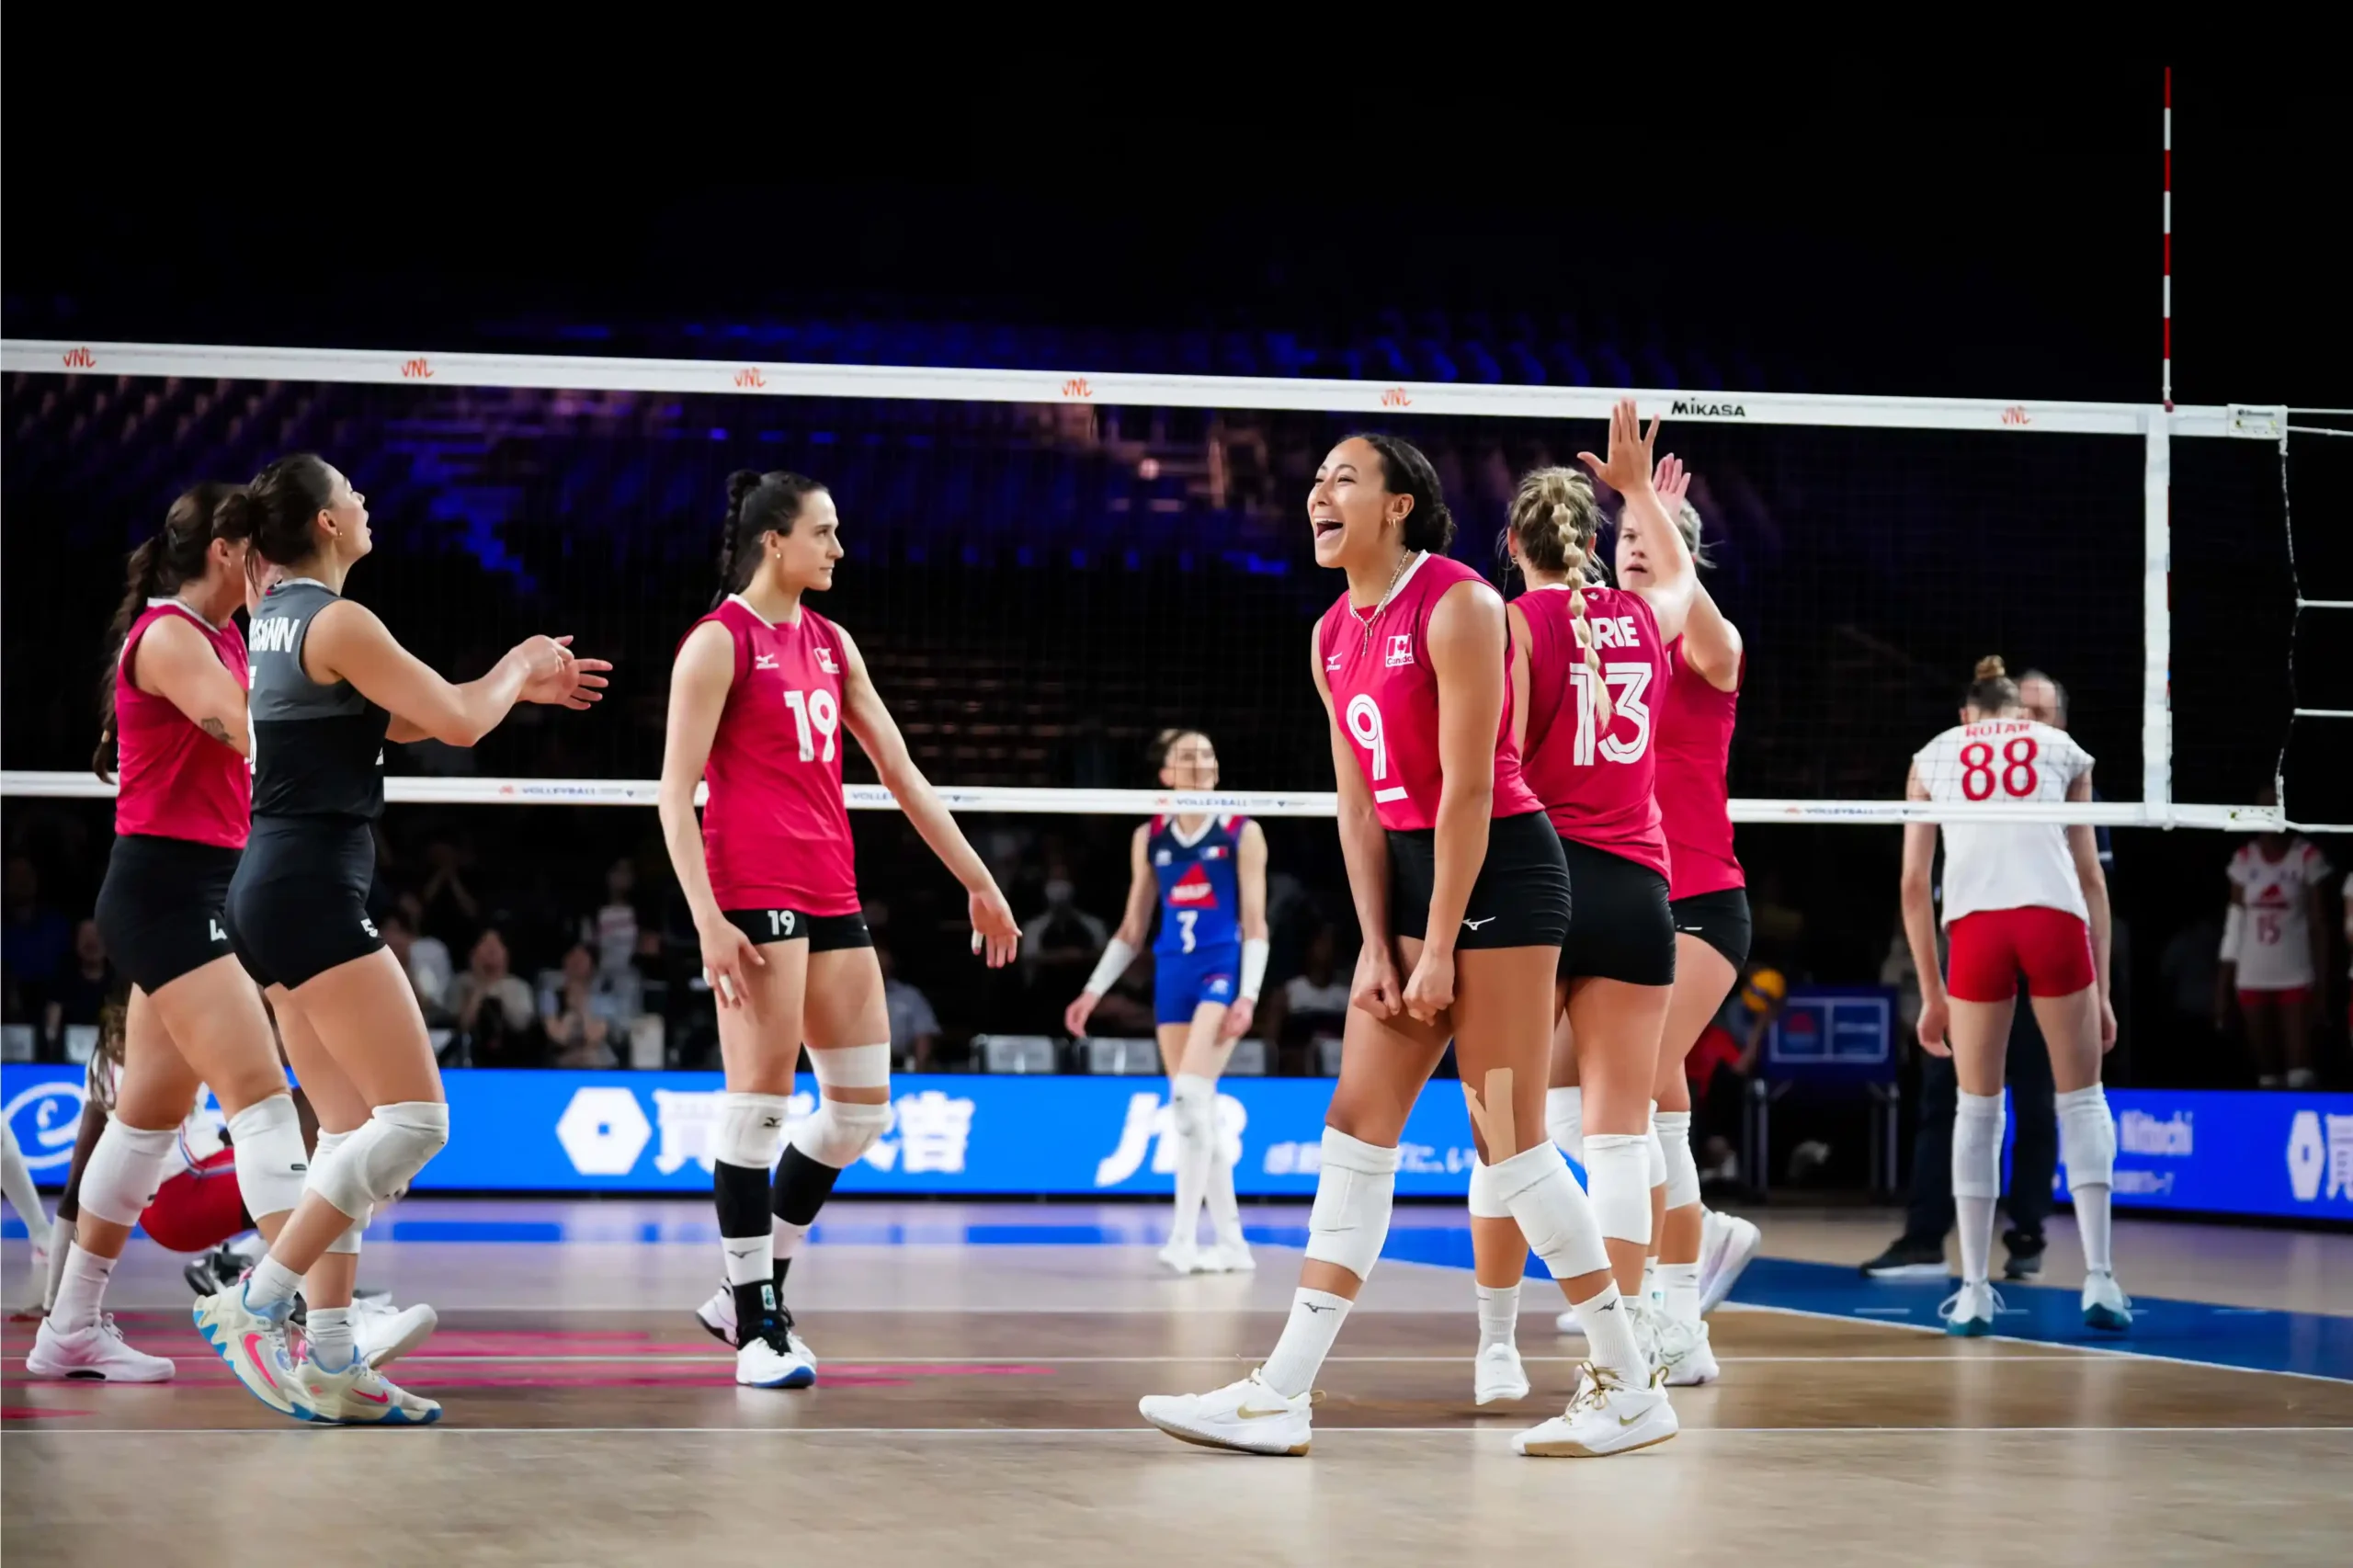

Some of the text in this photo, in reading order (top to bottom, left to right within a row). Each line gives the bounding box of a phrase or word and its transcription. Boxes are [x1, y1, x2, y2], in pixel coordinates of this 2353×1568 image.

[783, 688, 838, 762] 19
[1347, 693, 1387, 780] 9
[1569, 662, 1653, 766] 13
[522, 786, 596, 796] VOLLEYBALL
[1960, 737, 2038, 801] 88
[1176, 797, 1247, 807] VOLLEYBALL
[767, 910, 795, 936] 19
